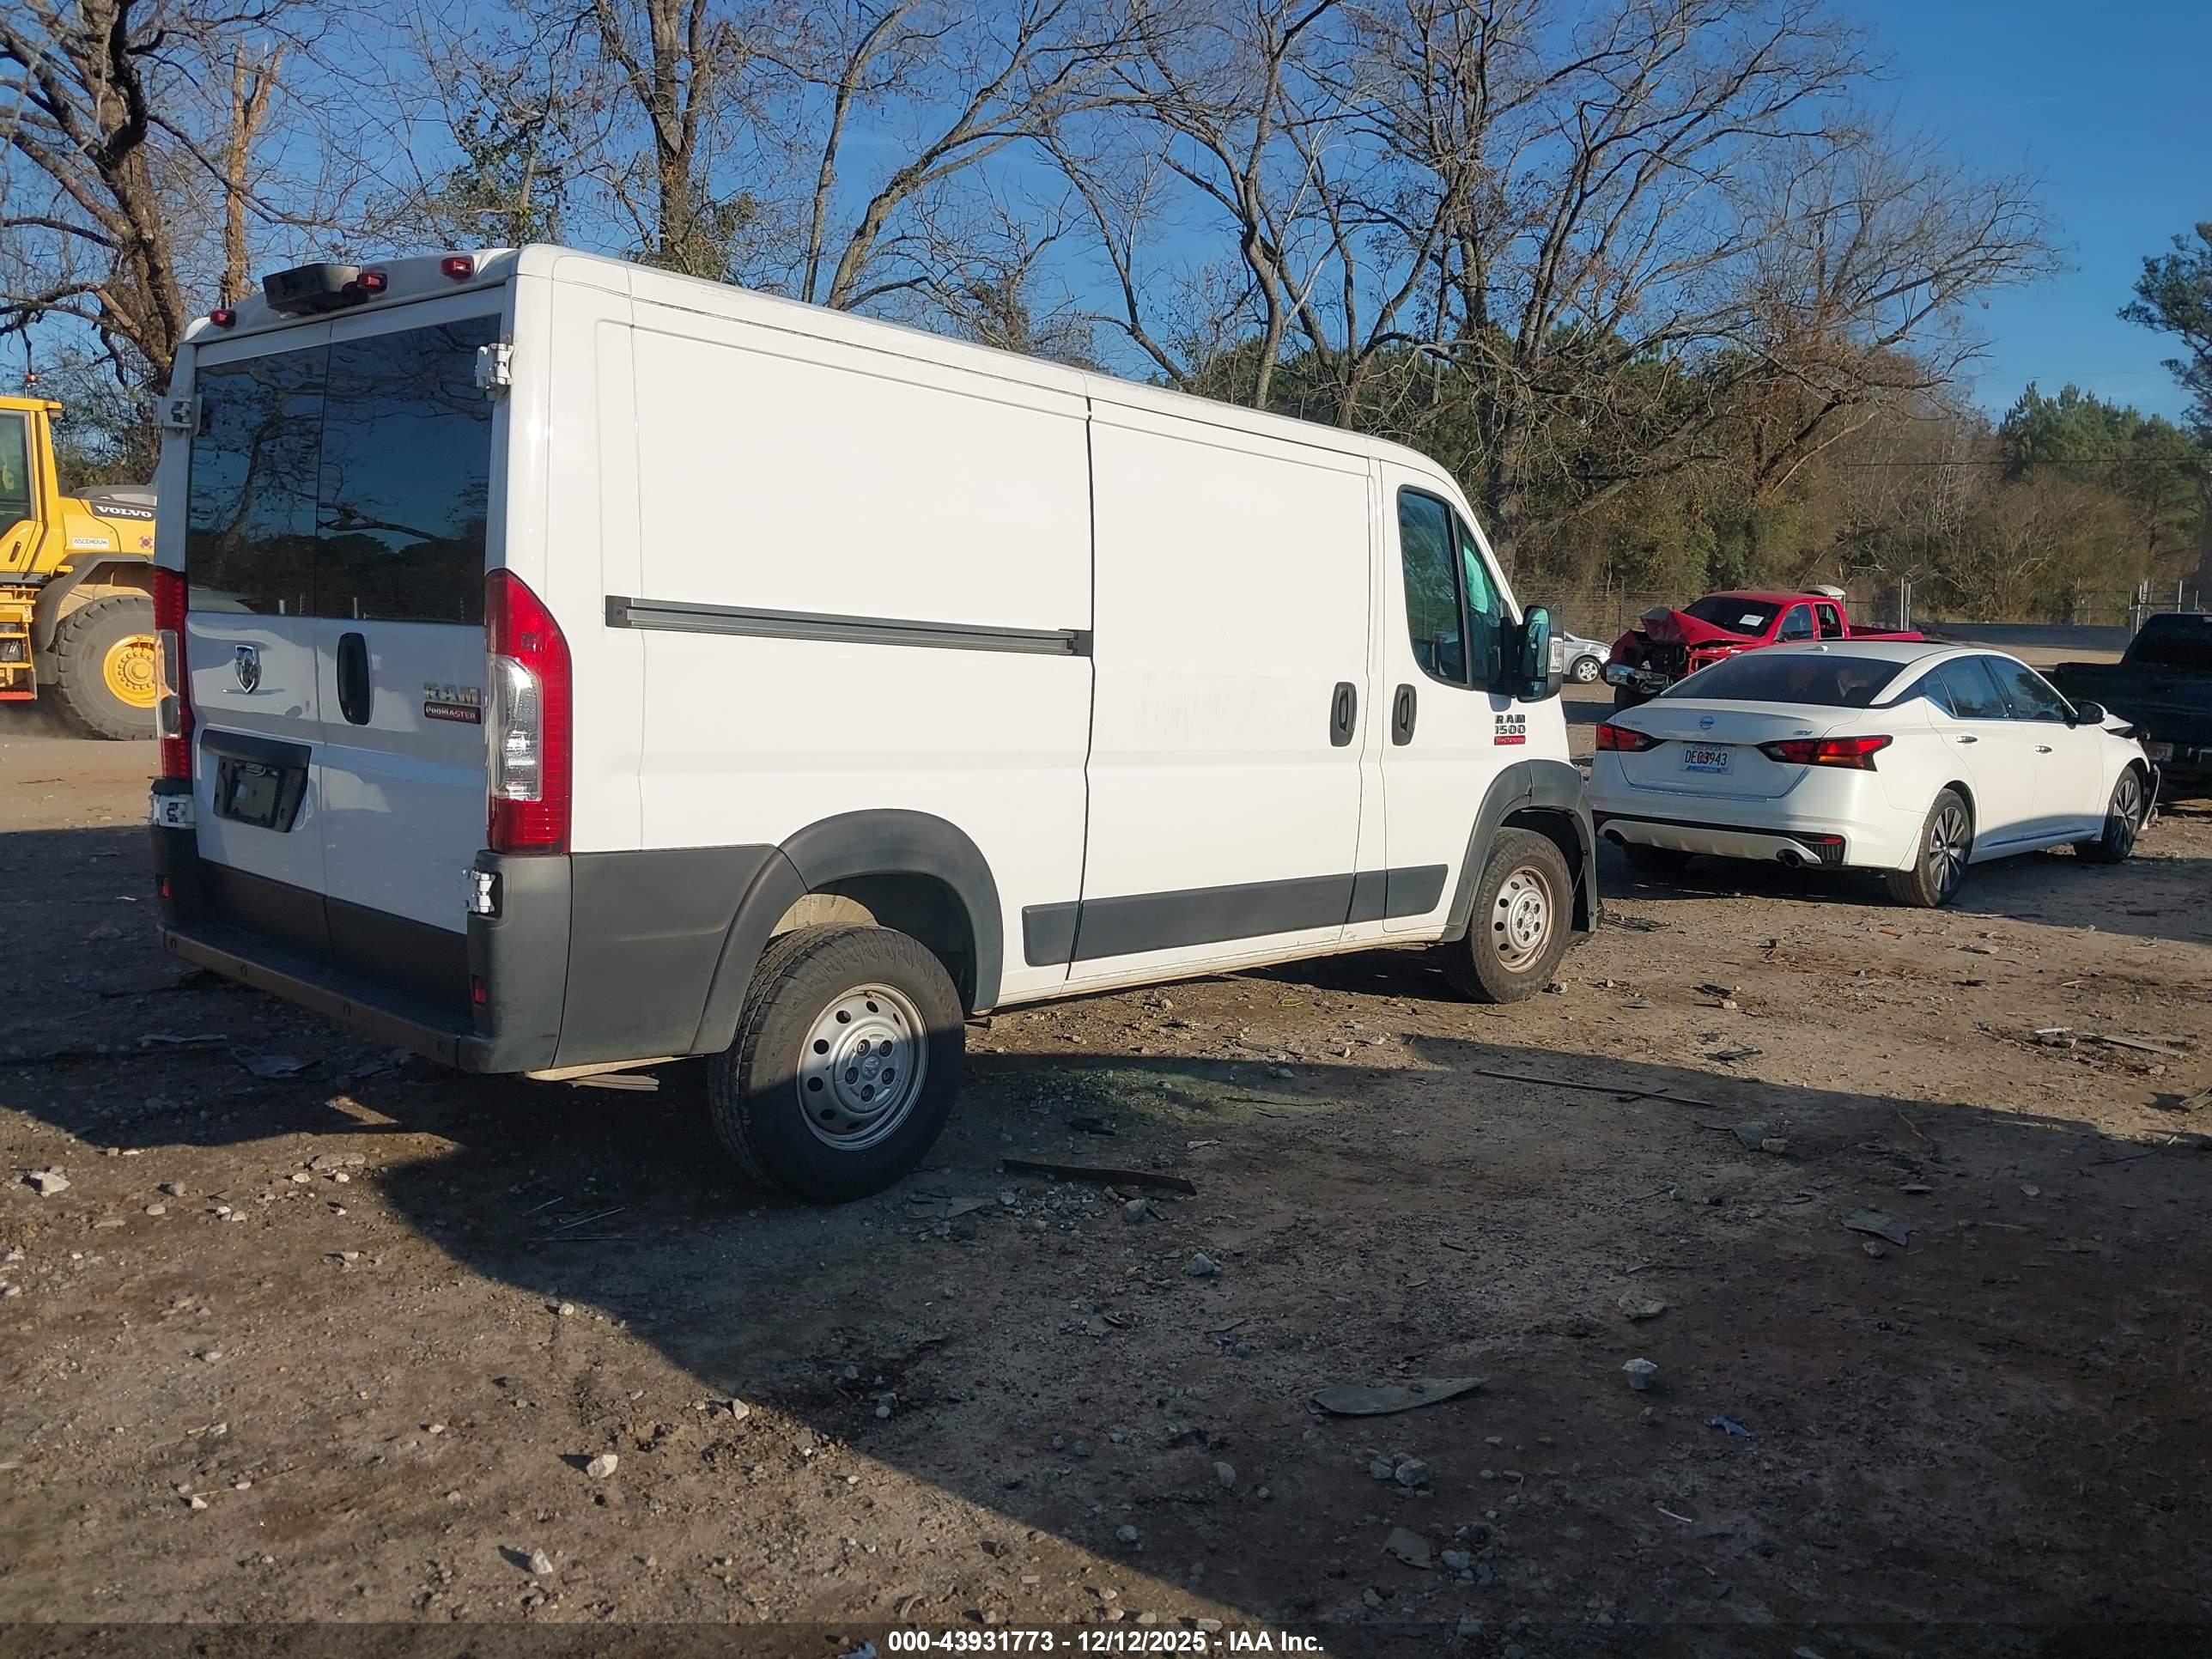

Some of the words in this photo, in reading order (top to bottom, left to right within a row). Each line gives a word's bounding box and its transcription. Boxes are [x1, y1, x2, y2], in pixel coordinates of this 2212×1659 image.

[95, 505, 152, 518] VOLVO
[1495, 714, 1526, 724] RAM
[1495, 725, 1526, 734] 1500
